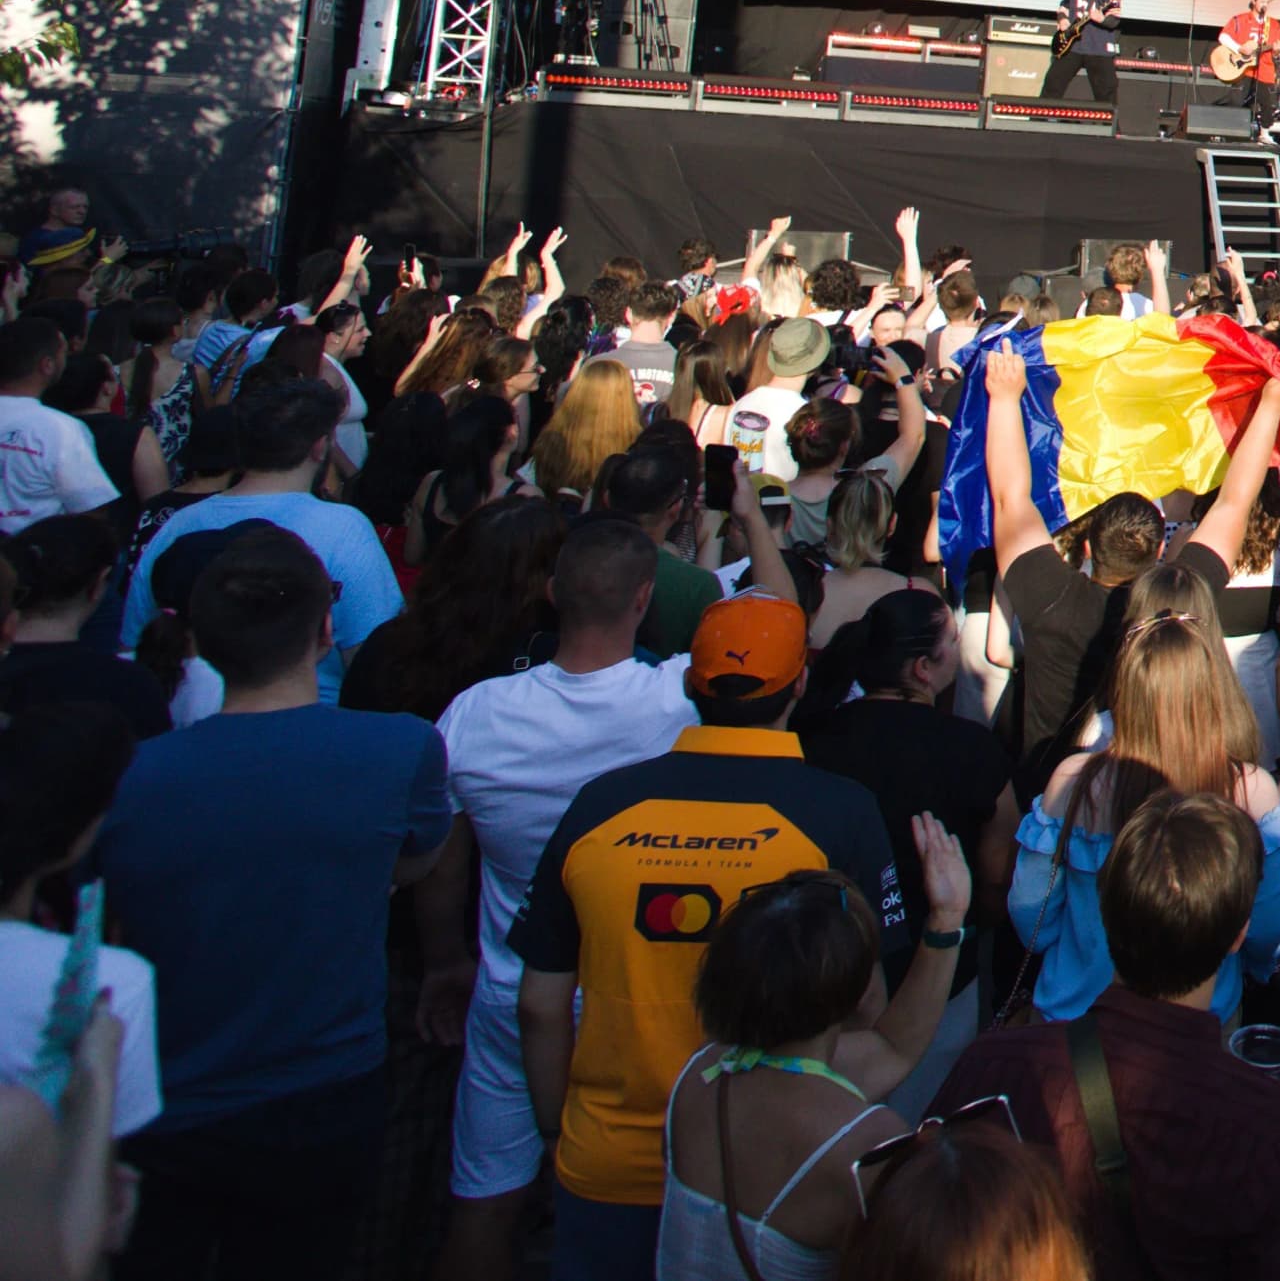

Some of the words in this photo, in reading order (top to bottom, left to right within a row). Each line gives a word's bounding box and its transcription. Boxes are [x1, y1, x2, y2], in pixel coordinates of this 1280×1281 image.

[613, 832, 758, 851] McLaren
[637, 858, 698, 868] FORMULA
[720, 861, 753, 869] TEAM
